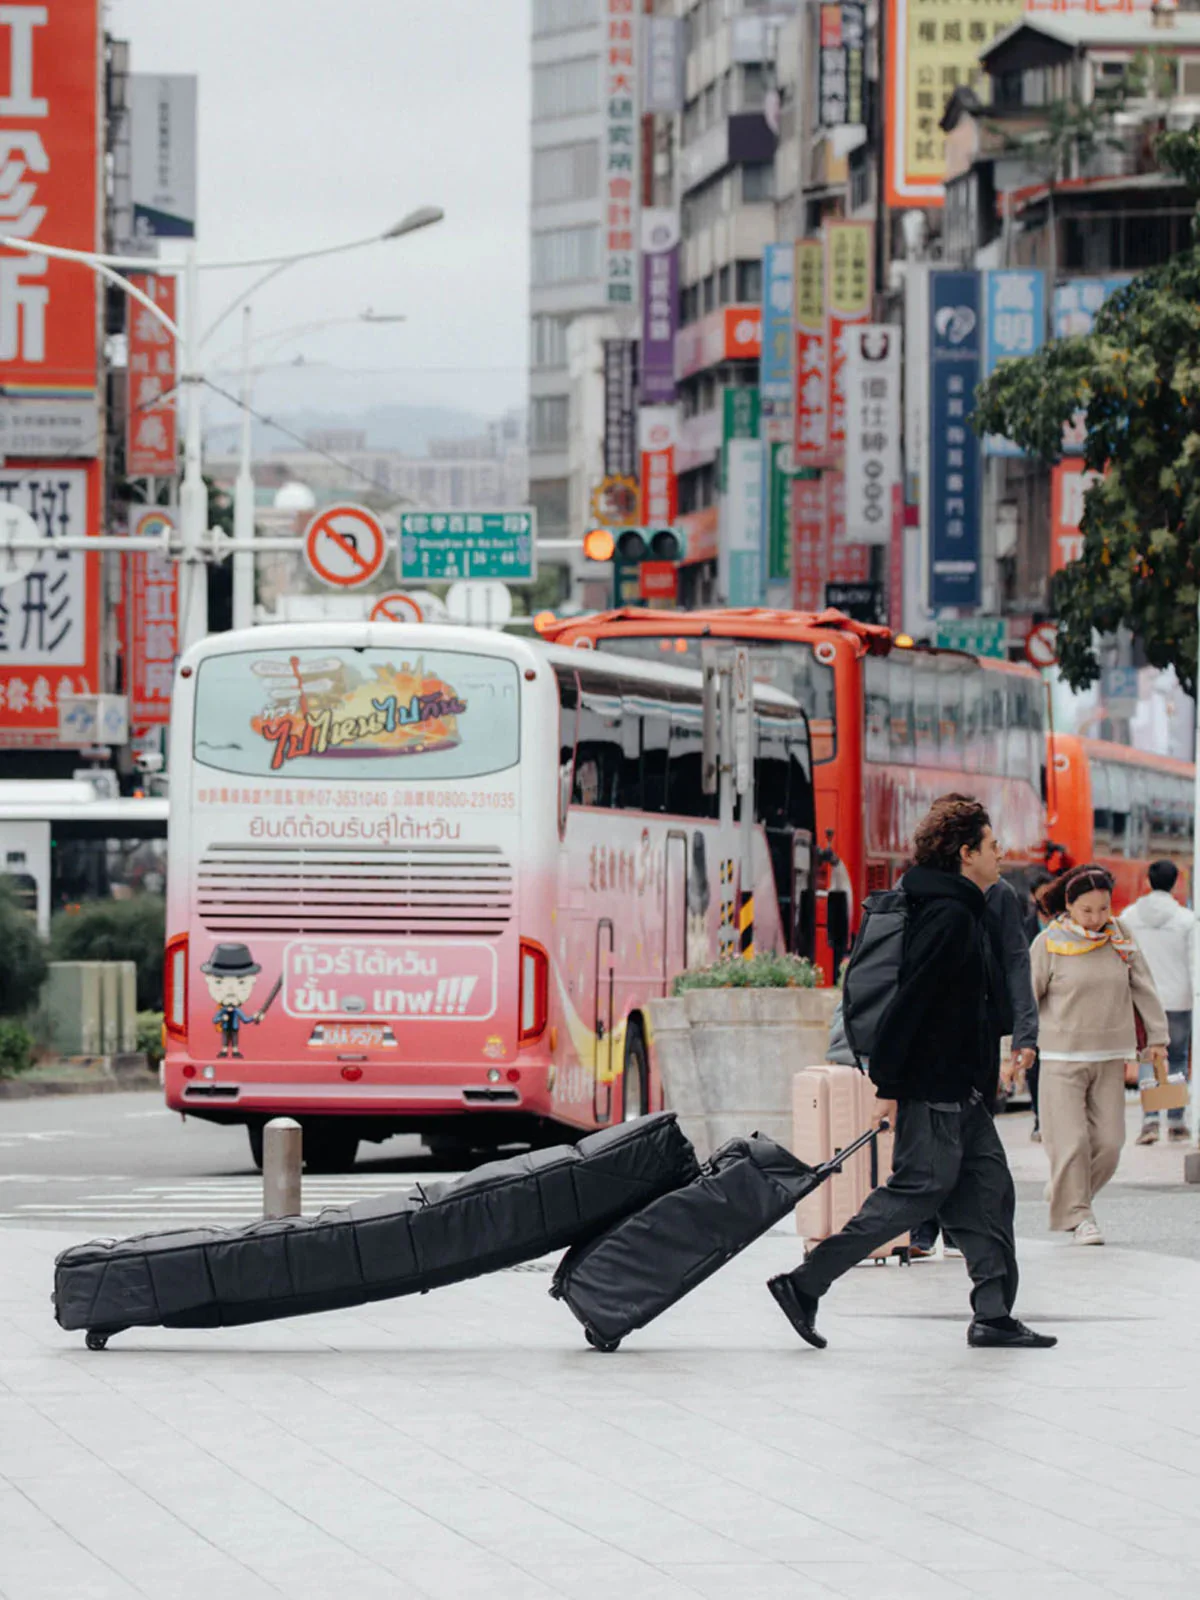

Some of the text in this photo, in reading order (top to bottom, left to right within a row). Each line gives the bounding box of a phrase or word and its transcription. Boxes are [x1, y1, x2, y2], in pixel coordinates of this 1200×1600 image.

[411, 515, 520, 534] 忠孝西路一段
[249, 812, 461, 845] ยินดีต้อนรับสู่ไต้หวัน
[373, 975, 478, 1013] เทพ!!!
